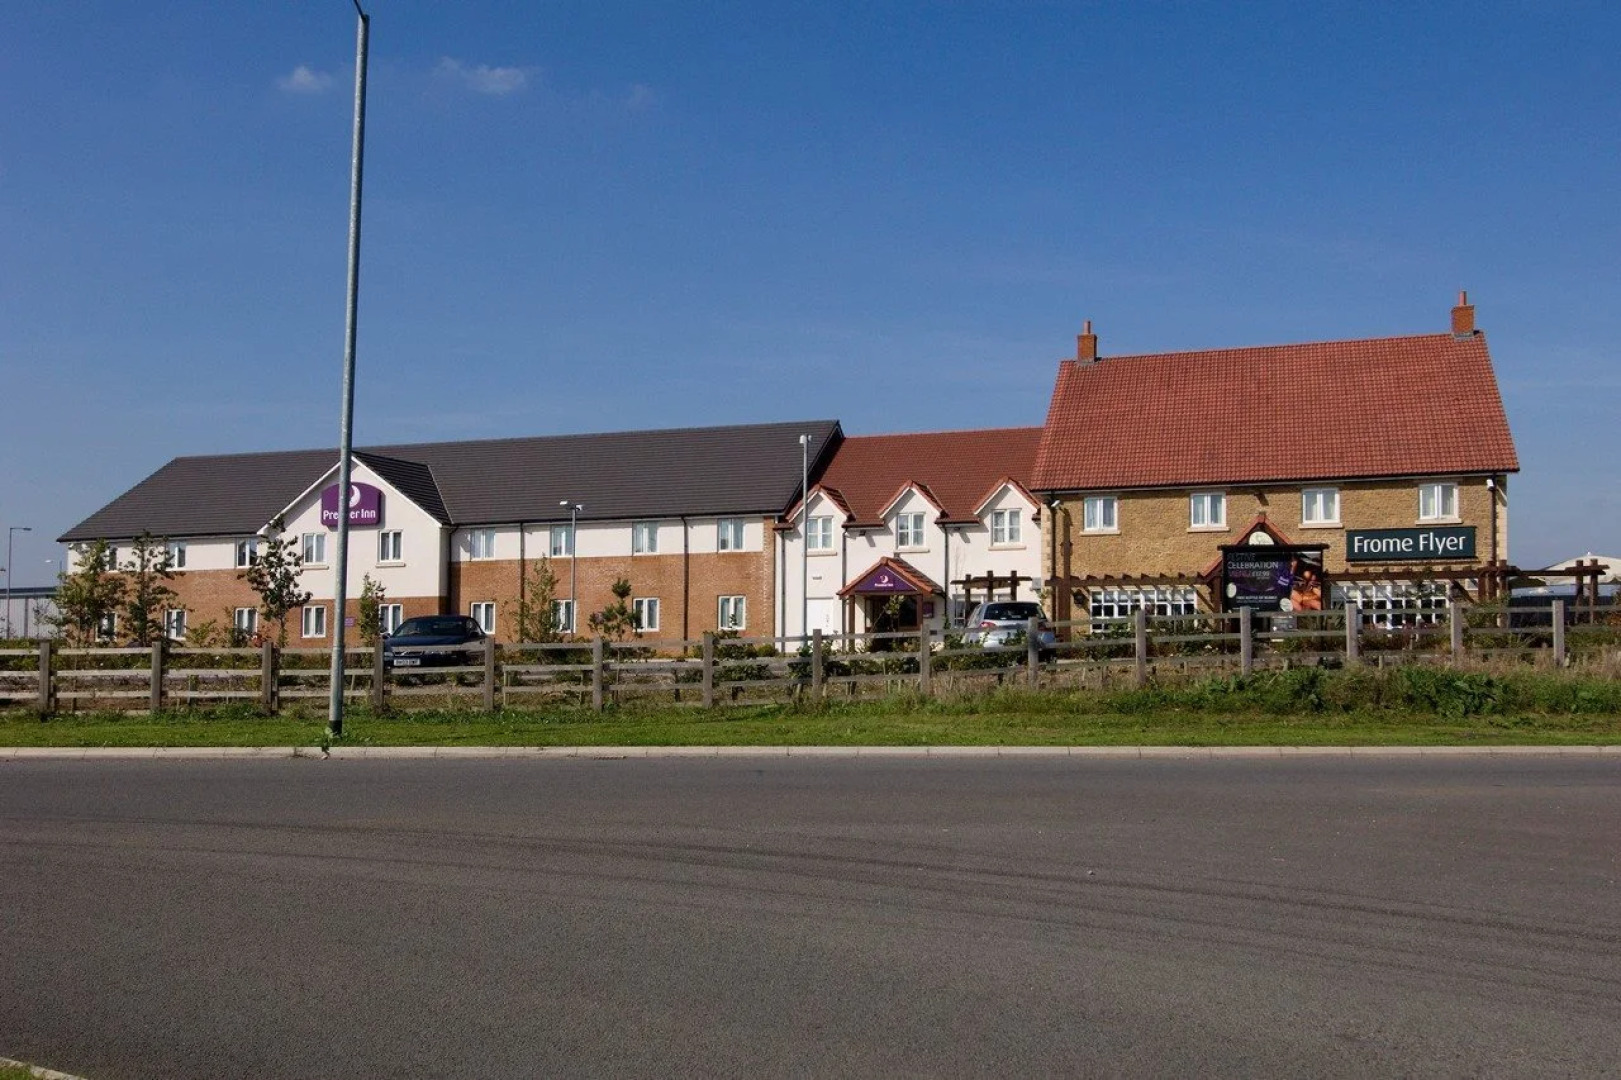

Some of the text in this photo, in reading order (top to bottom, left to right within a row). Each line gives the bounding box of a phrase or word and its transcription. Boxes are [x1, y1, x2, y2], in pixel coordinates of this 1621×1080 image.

[323, 508, 376, 520] Preer Inn
[1354, 532, 1466, 555] Frome Flyer
